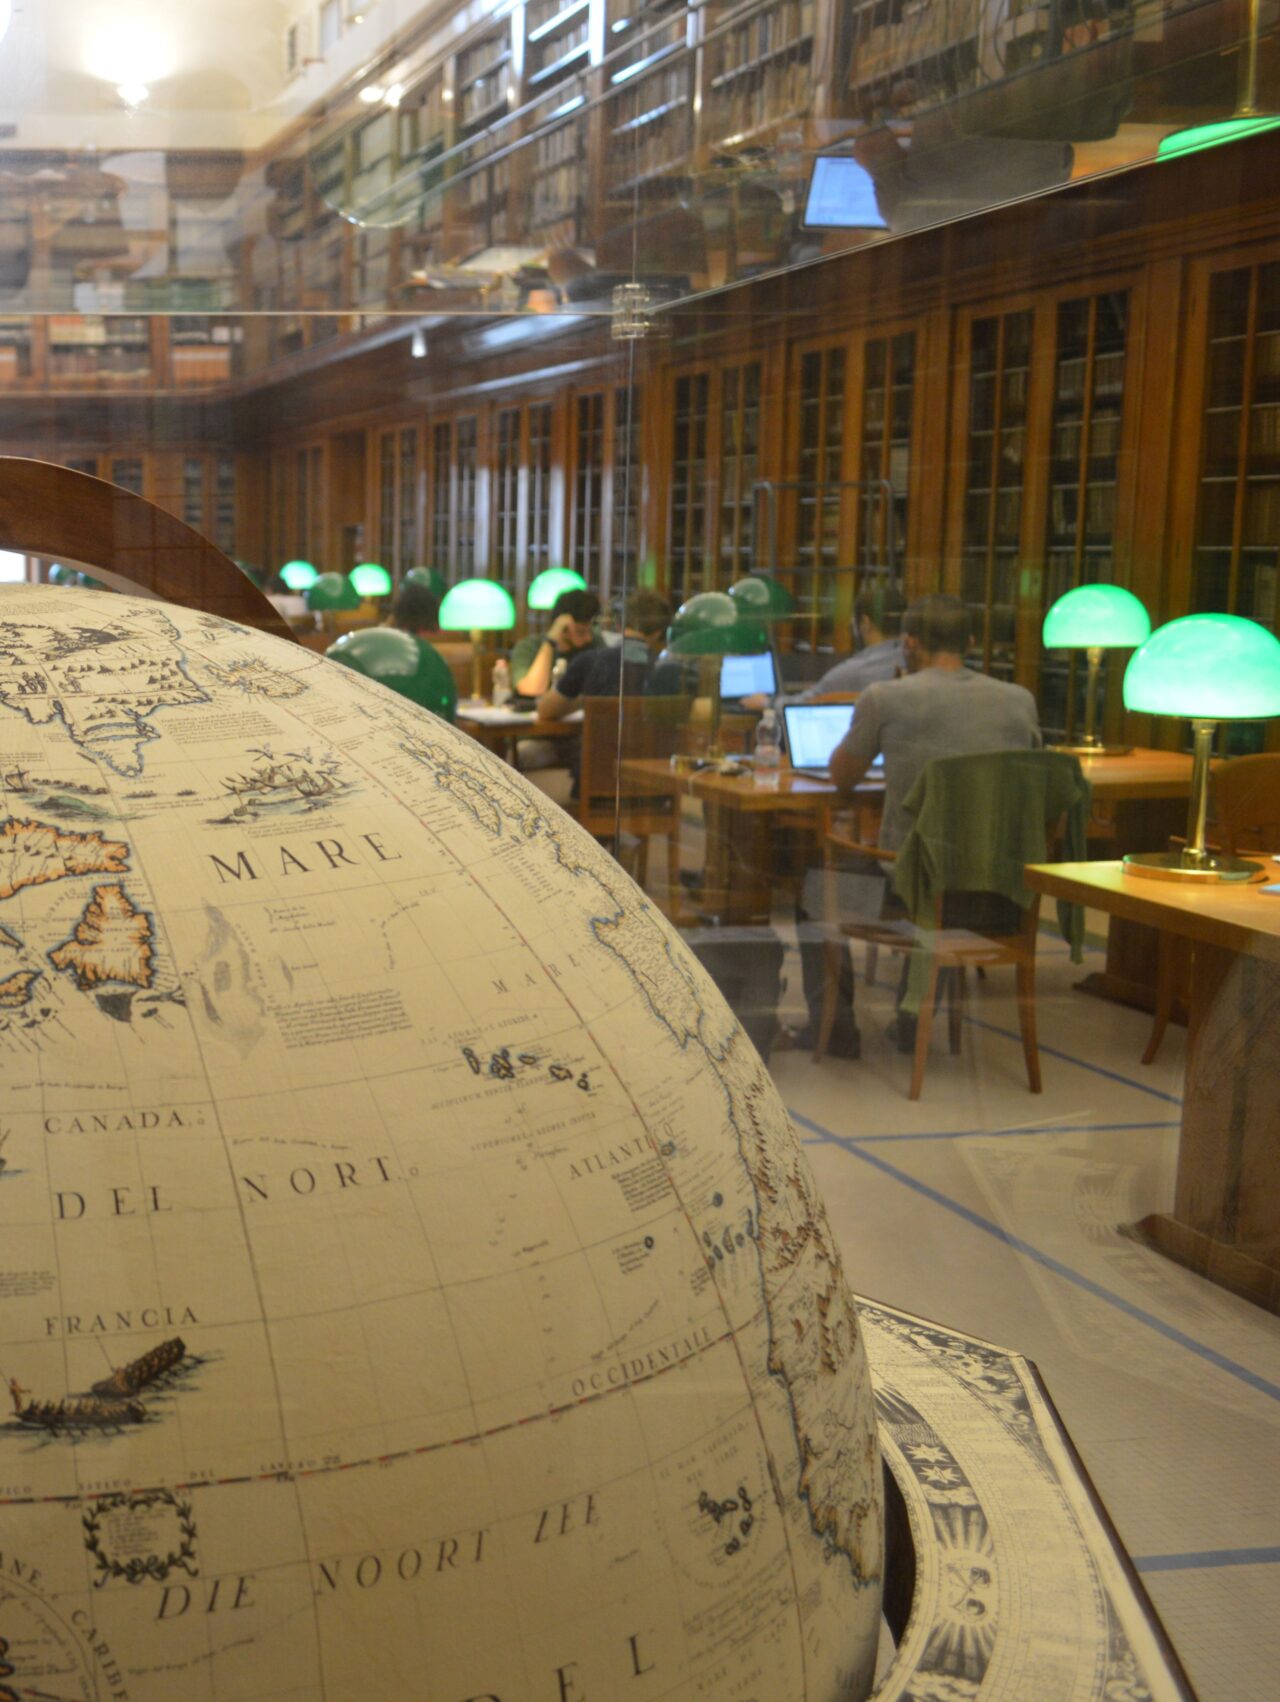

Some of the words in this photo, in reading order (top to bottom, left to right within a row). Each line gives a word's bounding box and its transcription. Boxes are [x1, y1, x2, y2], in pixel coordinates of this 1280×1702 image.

[206, 832, 403, 884] MARE
[569, 1121, 677, 1180] ATLANTICO
[56, 1185, 173, 1220] DEL
[45, 1306, 199, 1337] FRANCIA
[571, 1325, 712, 1397] OCCIDENTALE
[156, 1574, 258, 1620] DIE
[314, 1530, 493, 1597] NOORT
